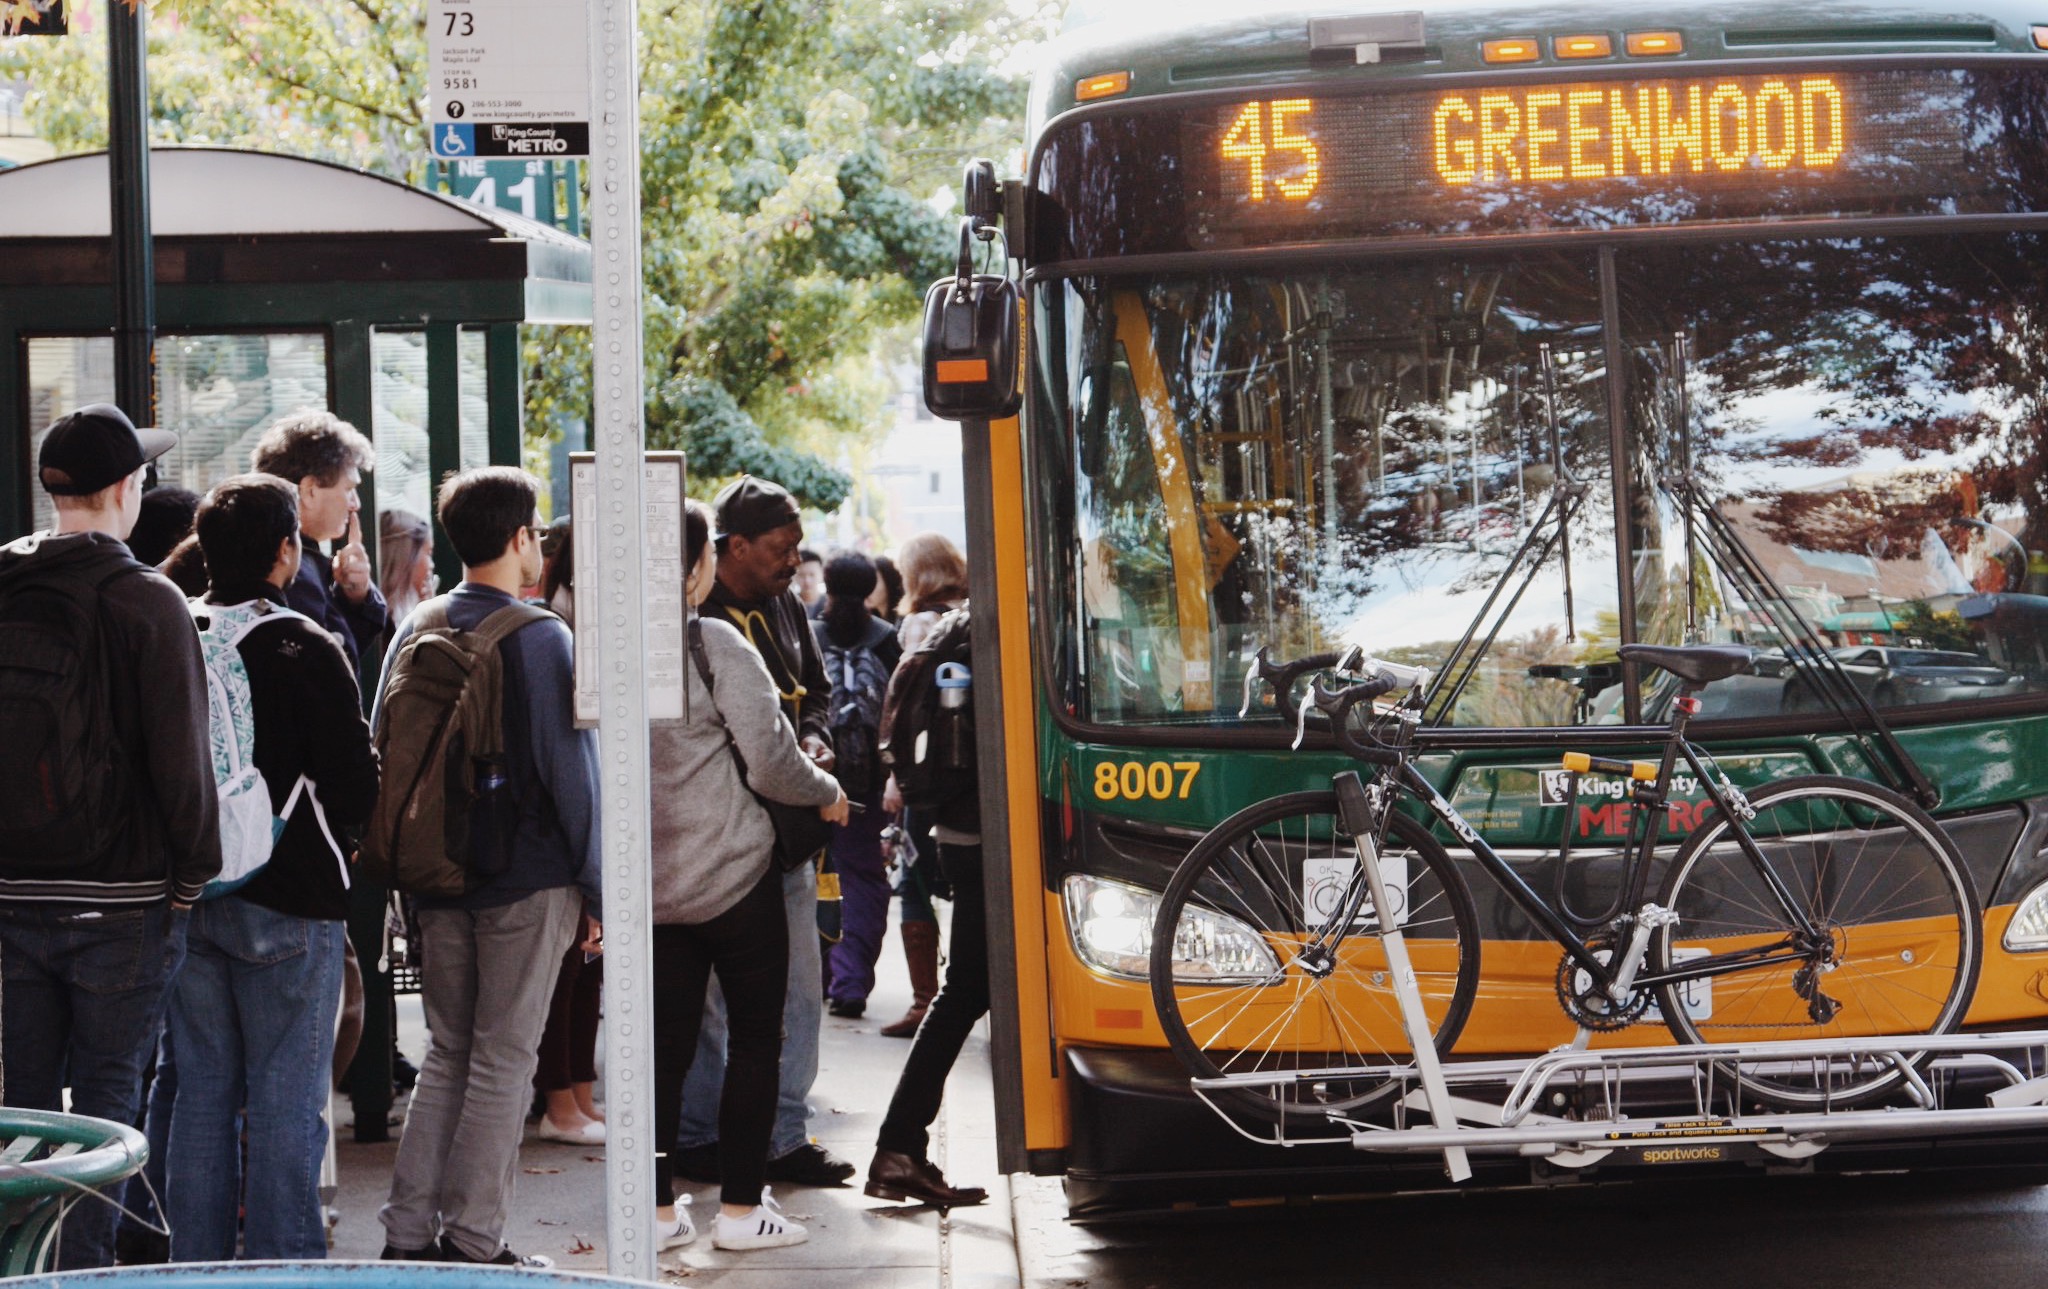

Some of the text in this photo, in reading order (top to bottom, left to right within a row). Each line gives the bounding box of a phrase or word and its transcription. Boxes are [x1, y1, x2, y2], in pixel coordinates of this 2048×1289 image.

[443, 12, 474, 36] 73
[443, 78, 477, 89] 9581
[507, 127, 556, 139] King County
[1221, 80, 1843, 200] 45 GREENWOOD
[507, 138, 568, 153] METRO
[458, 160, 487, 177] NE
[1093, 760, 1201, 800] 8007
[1578, 777, 1624, 799] King
[1319, 865, 1333, 875] OK
[1632, 1130, 1650, 1138] Push
[1669, 1129, 1682, 1137] and
[1683, 1128, 1712, 1137] squeeze
[1714, 1127, 1738, 1135] handle
[1748, 1126, 1768, 1134] lower
[1643, 1146, 1720, 1162] sportworks
